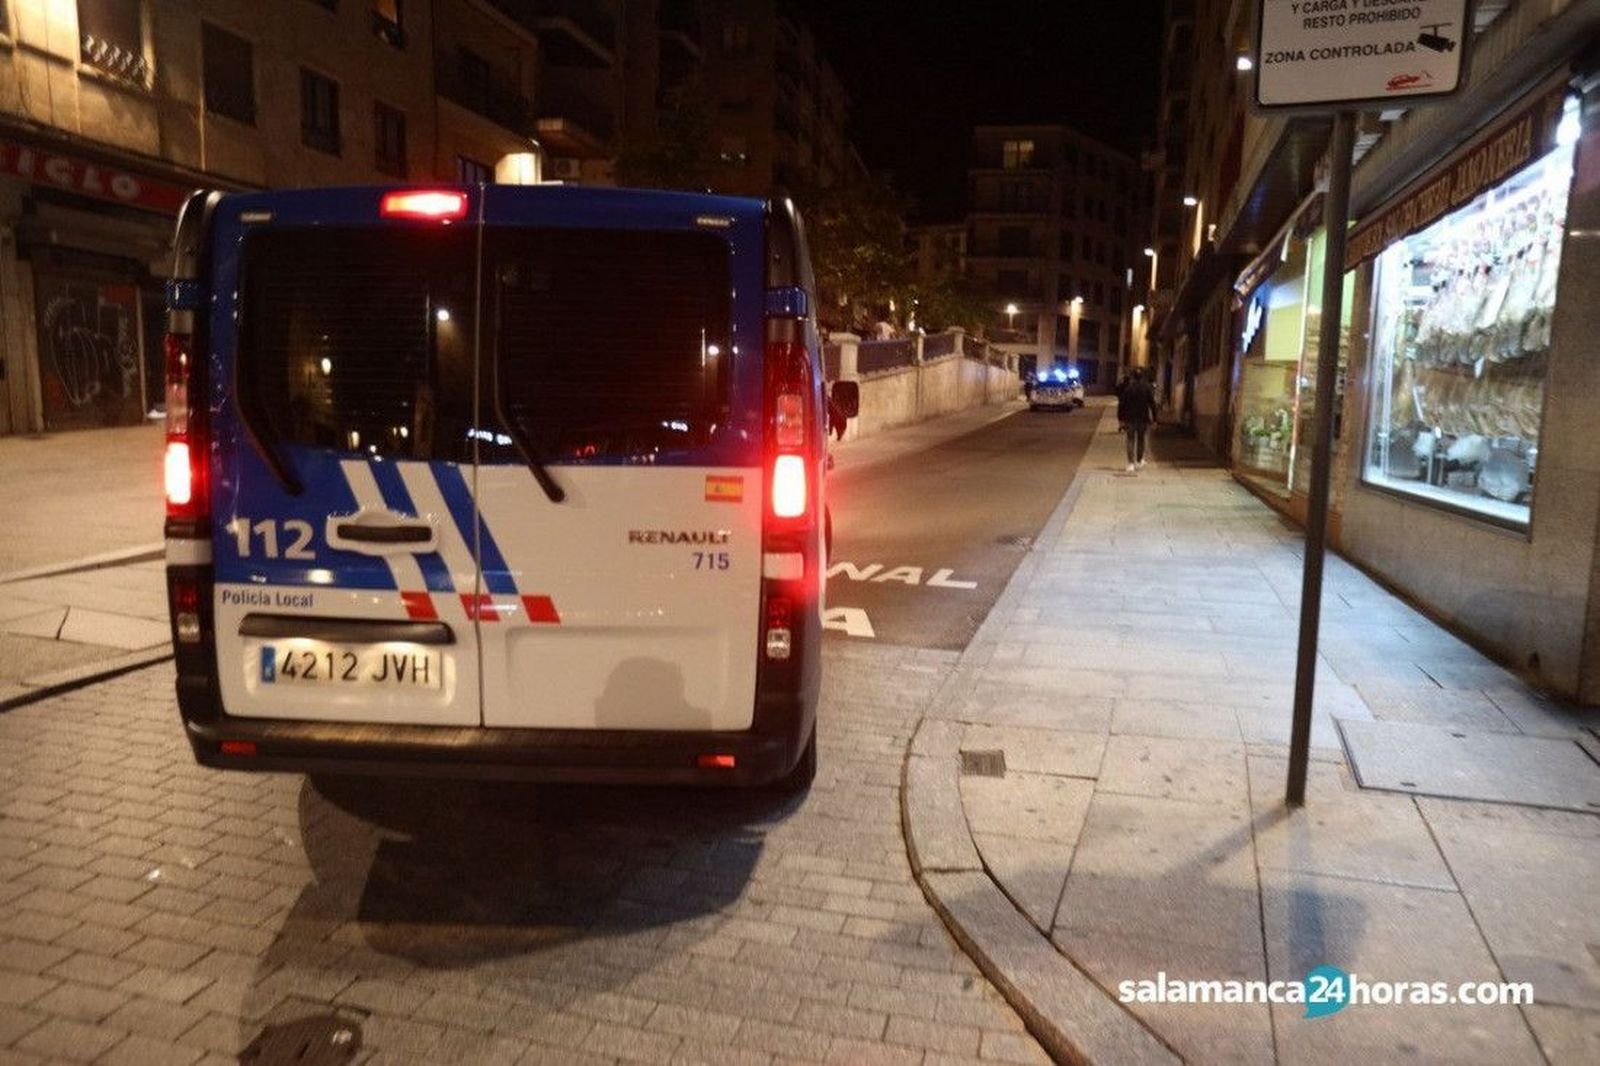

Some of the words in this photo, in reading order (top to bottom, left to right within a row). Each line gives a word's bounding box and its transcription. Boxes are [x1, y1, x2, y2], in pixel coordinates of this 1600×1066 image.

[1292, 3, 1299, 14] Y
[1302, 0, 1347, 13] CARGA
[1303, 14, 1345, 29] RESTO
[1349, 7, 1421, 25] PROHIBIDO
[1265, 51, 1305, 64] ZONA
[1310, 41, 1415, 60] CONTROLADA
[226, 518, 316, 559] 112
[628, 530, 729, 544] RENAULT
[692, 552, 730, 570] 715
[827, 561, 978, 589] NAL
[276, 591, 314, 607] Local
[281, 651, 358, 680] 4212
[372, 653, 429, 684] JVH
